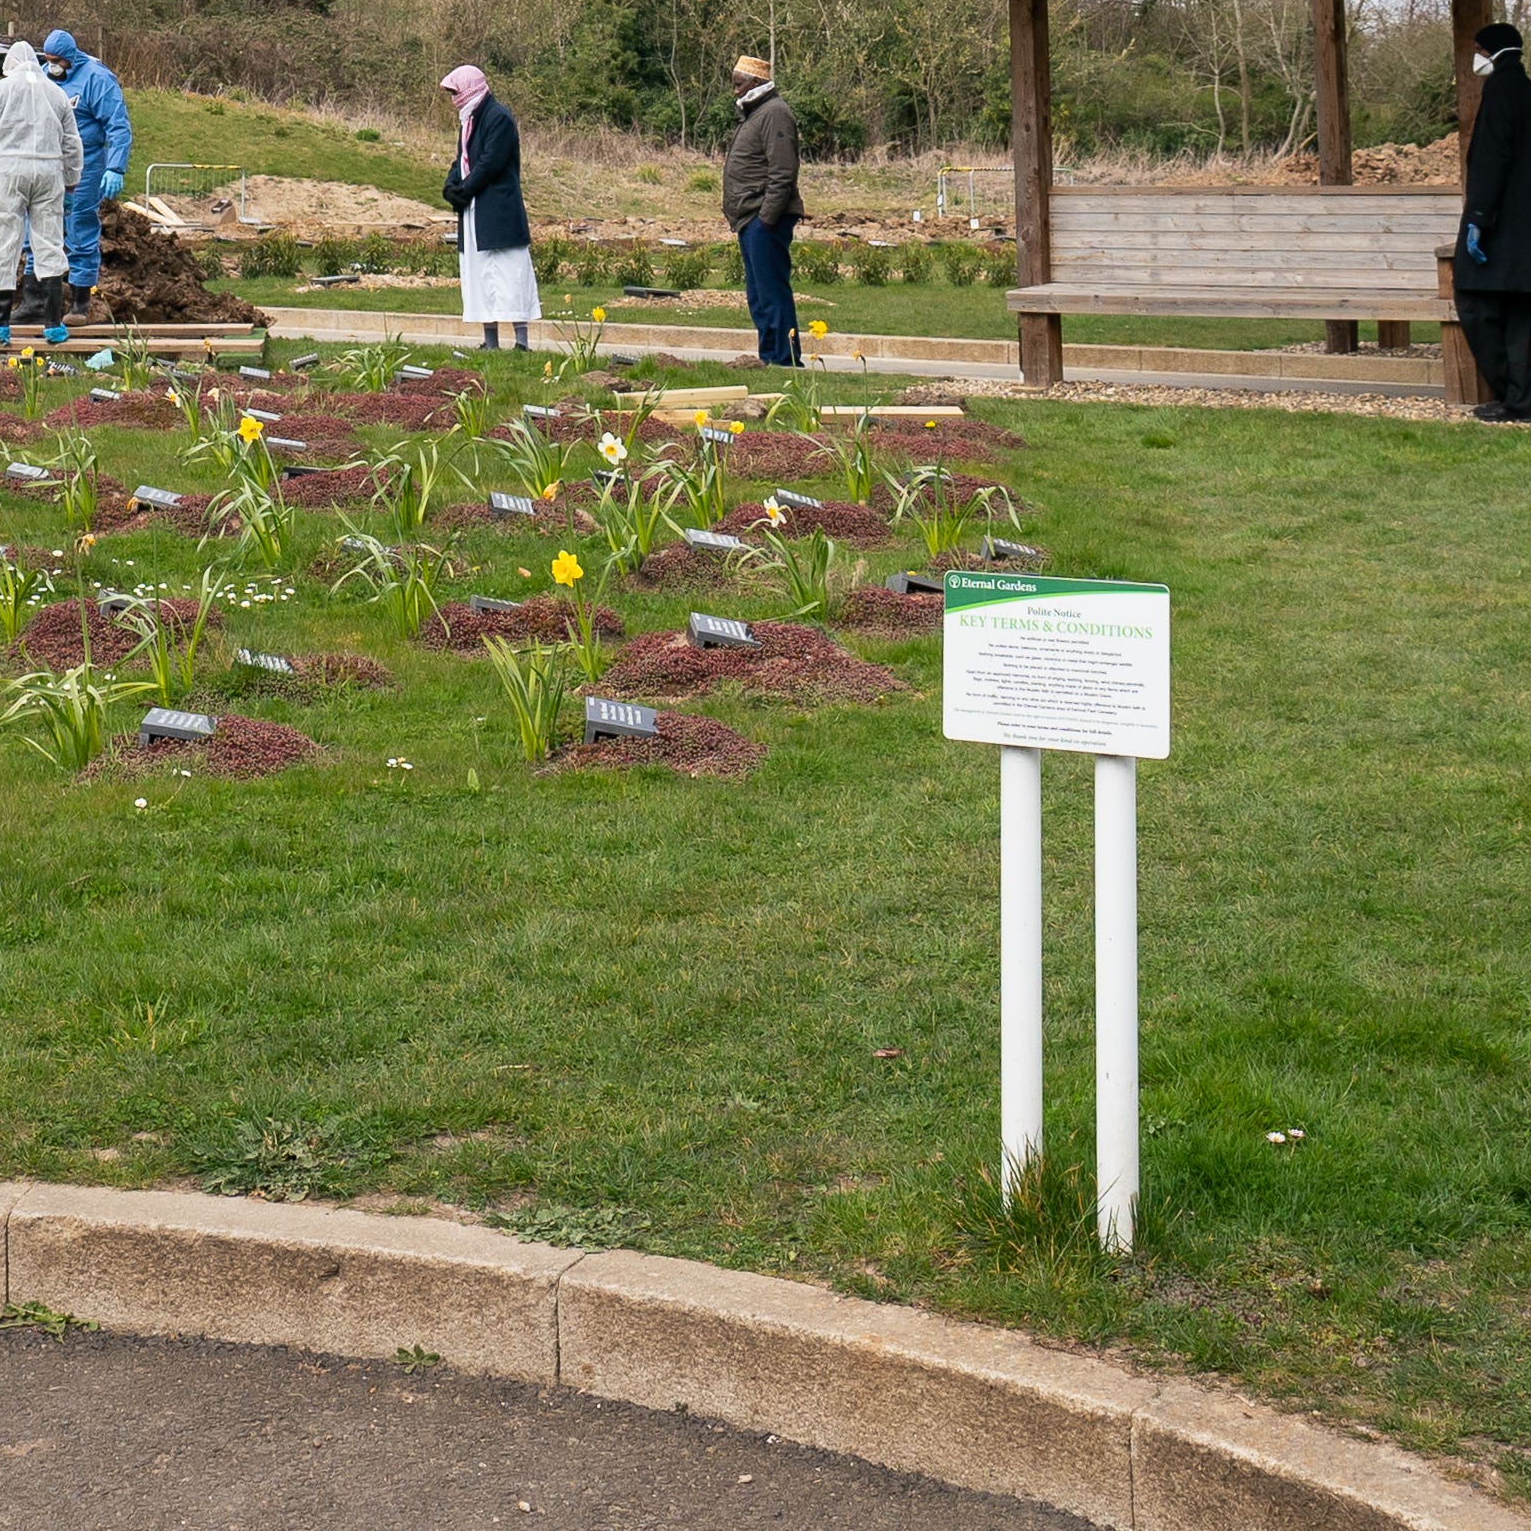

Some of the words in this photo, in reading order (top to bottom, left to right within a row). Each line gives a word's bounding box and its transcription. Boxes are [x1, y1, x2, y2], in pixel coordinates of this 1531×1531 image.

[961, 577, 995, 590] Eternal
[997, 579, 1037, 592] Gardens
[1027, 606, 1052, 617] Polite
[1054, 608, 1081, 618] Notice
[959, 614, 986, 627] KEY
[991, 616, 1039, 631] TERMS
[1042, 620, 1052, 632] &
[1056, 621, 1153, 639] CONDITIONS
